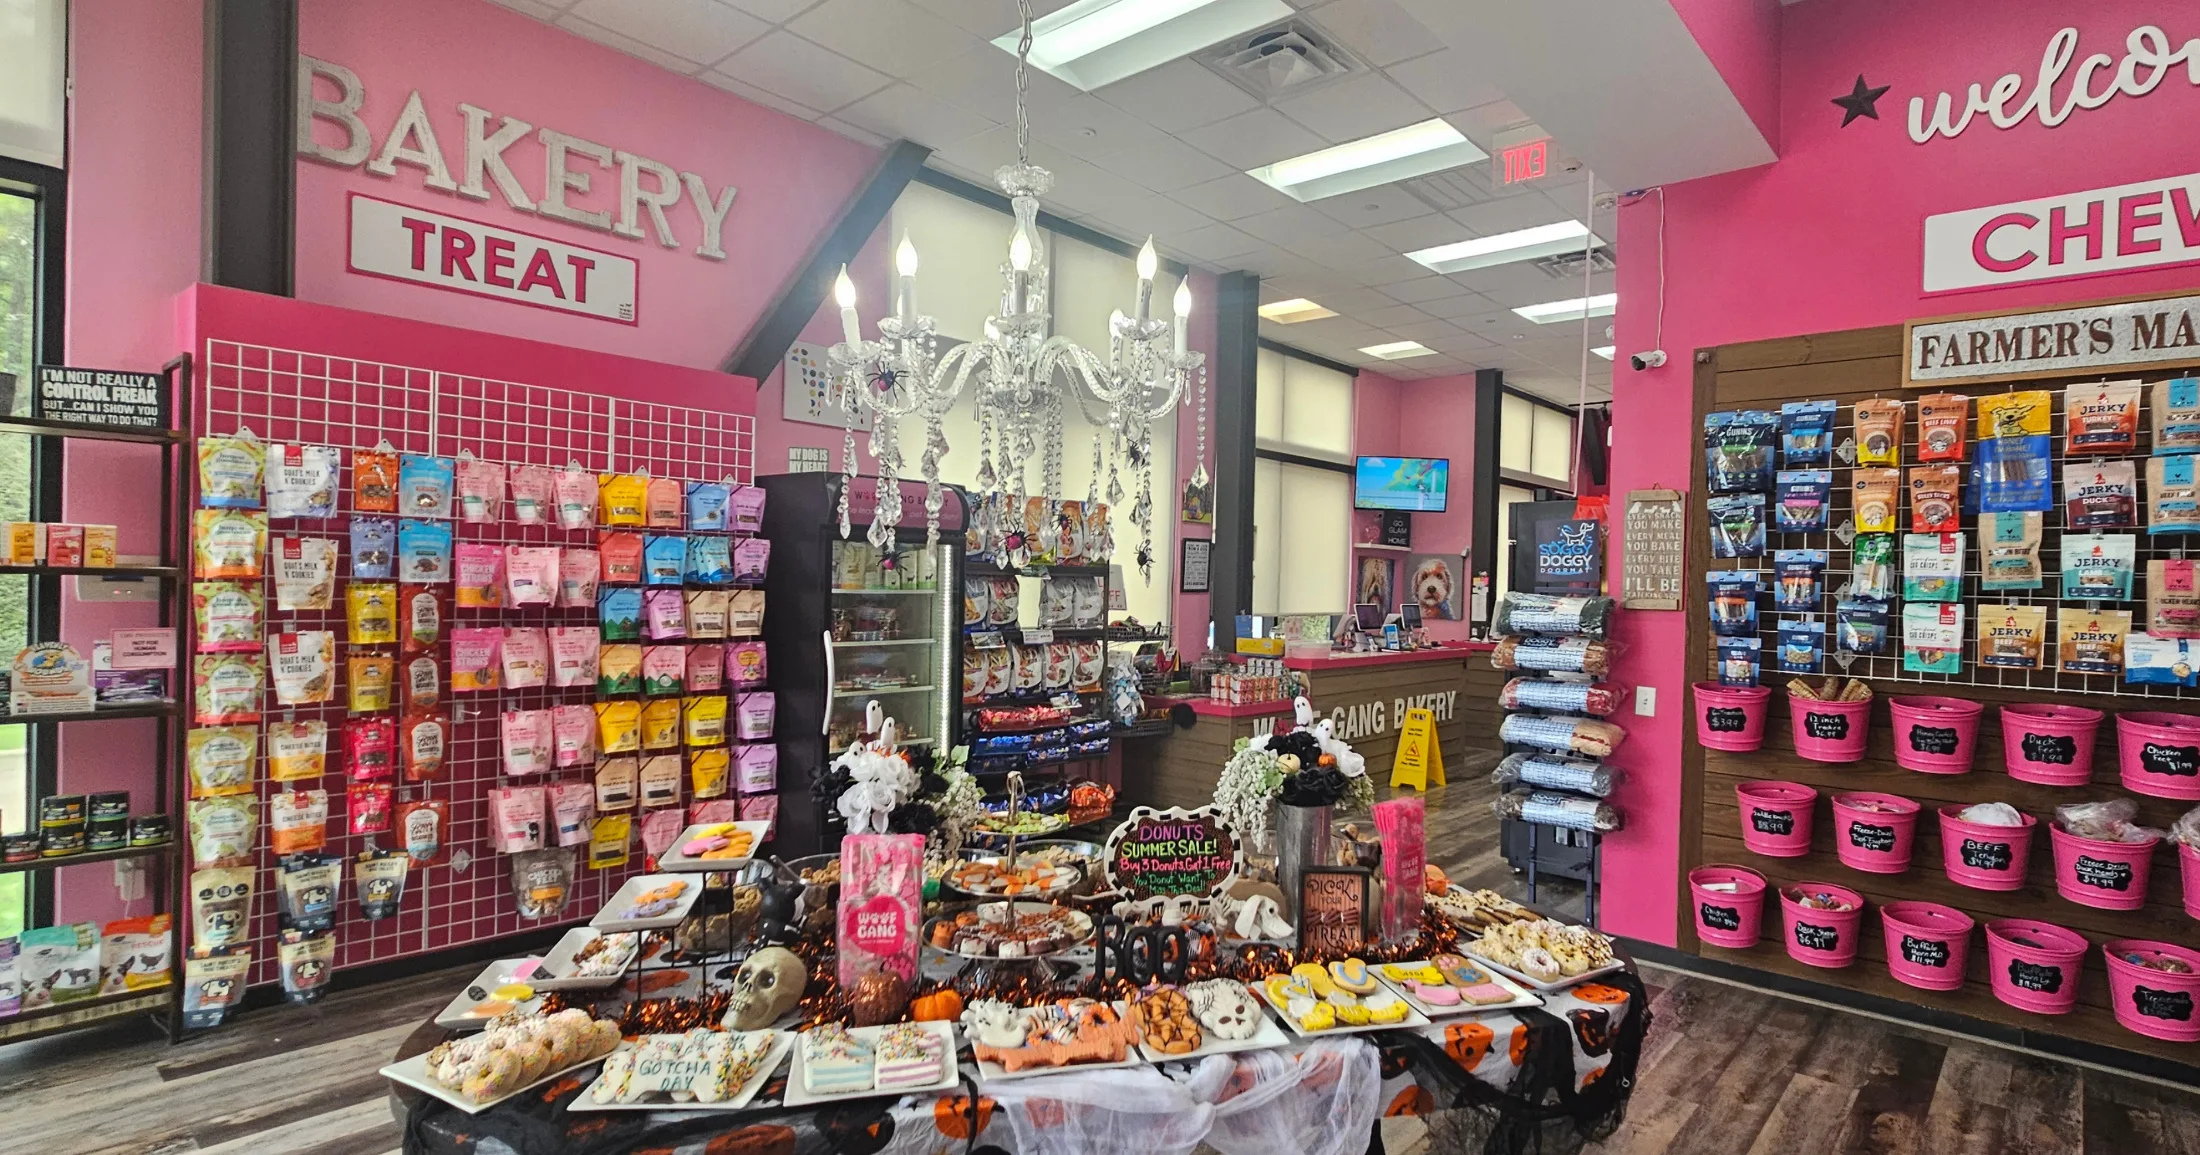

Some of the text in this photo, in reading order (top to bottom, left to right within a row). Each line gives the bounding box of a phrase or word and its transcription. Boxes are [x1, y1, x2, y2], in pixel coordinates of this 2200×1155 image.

[298, 52, 738, 260] BAKERY
[401, 216, 596, 303] TREAT
[1919, 317, 2114, 369] FARMER'S
[42, 369, 157, 388] I'M NOT REALLY A
[42, 382, 157, 404] CONTROL FREAK
[96, 402, 101, 412] I
[102, 402, 135, 414] SHOW
[138, 404, 158, 416] YOU
[2080, 403, 2126, 415] JERKY
[45, 411, 157, 427] THE RIGHT WAY TO DO THAT?
[789, 447, 828, 461] MY DOG IS
[803, 461, 828, 472] HEART
[290, 477, 316, 486] COOKIES
[2078, 484, 2125, 496] JERKY
[2083, 497, 2109, 505] DUCK
[1393, 519, 1404, 527] GO
[1627, 520, 1681, 530] YOU MAKE
[1388, 537, 1407, 545] HOME
[1627, 532, 1680, 541] EVERY MEAL
[1539, 542, 1592, 555] SOGGY
[1627, 541, 1680, 551] YOU BAKE
[1539, 555, 1593, 567] DOGGY
[1626, 554, 1680, 563] EVERY BITE
[2074, 558, 2121, 568] JERKY
[1626, 564, 1680, 575] YOU TAKE
[1626, 577, 1680, 592] I'LL BE
[1990, 627, 2033, 638] JERKY
[2071, 632, 2118, 643] JERKY
[1994, 638, 2013, 646] BEEF
[2076, 643, 2097, 651] BEEF
[1331, 701, 1385, 740] GANG
[2028, 735, 2057, 746] Duck
[2147, 745, 2181, 757] Chicken
[1140, 824, 1205, 842] DONUTS
[1121, 838, 1218, 858] SUMMER SALE!
[1966, 840, 2002, 852] BEEF
[1120, 857, 1140, 875] Buy
[1142, 858, 1150, 870] 3
[1202, 855, 1211, 869] 1
[1211, 856, 1232, 870] Free
[1133, 875, 1148, 886] You
[1204, 869, 1216, 880] To
[1306, 878, 1359, 902] PICK
[1321, 895, 1342, 905] YOUR
[857, 924, 897, 939] GANG
[1306, 925, 1357, 949] TREAT
[640, 1059, 711, 1076] GOTCHA
[660, 1075, 695, 1092] DAY
